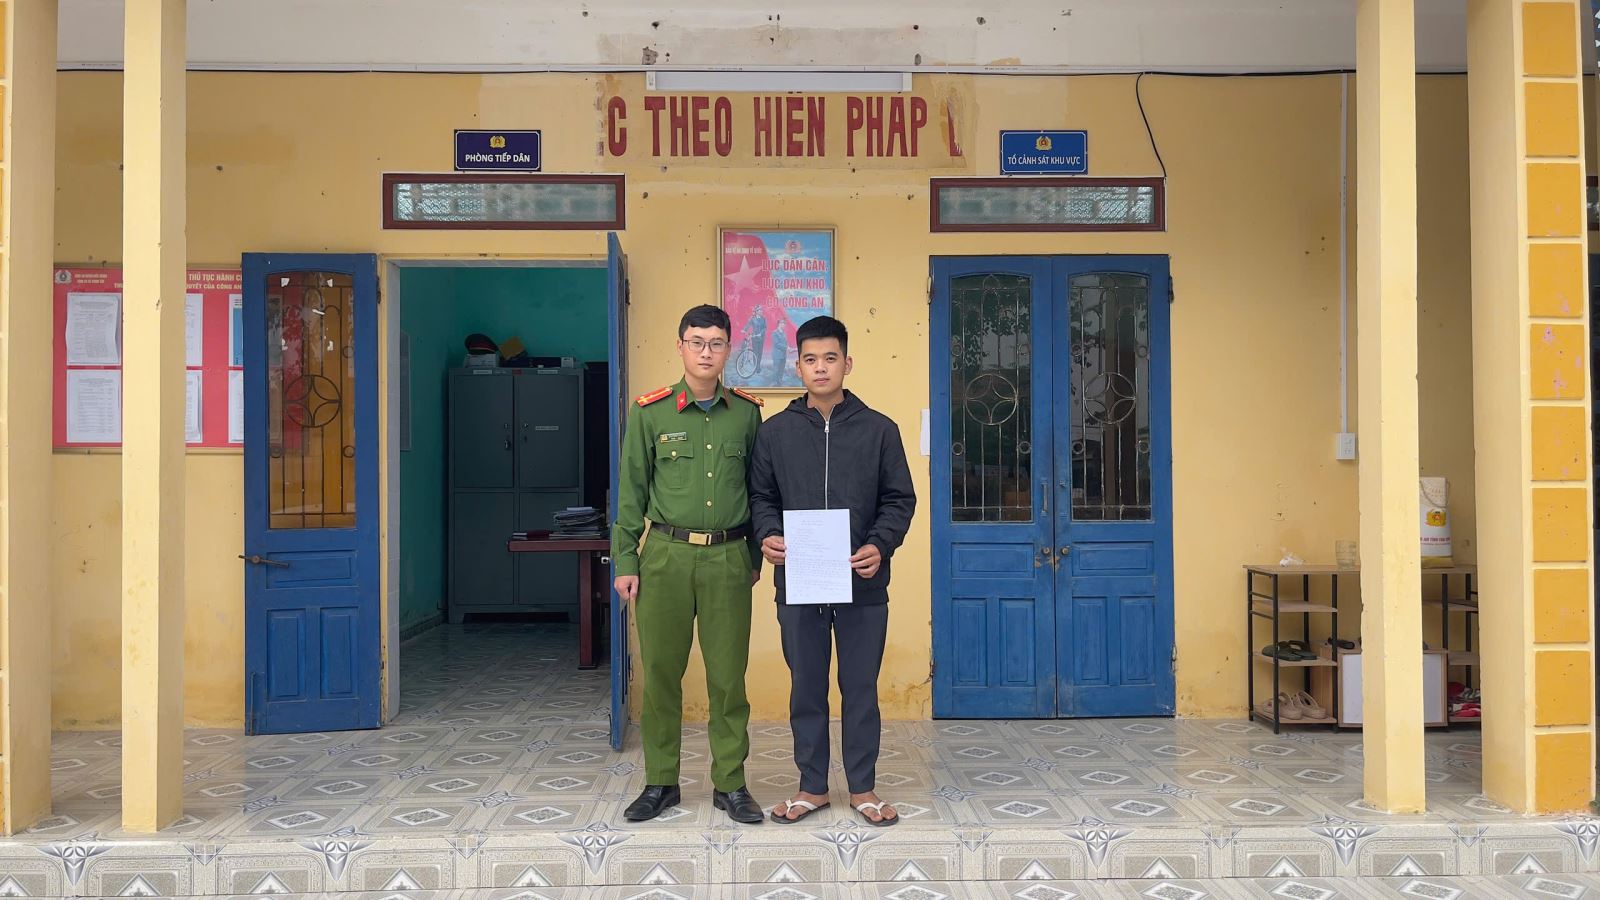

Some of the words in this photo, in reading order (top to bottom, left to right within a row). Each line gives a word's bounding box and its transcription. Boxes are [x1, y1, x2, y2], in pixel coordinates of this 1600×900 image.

[602, 95, 628, 157] C
[644, 96, 732, 157] THEO
[465, 152, 494, 162] PHÒNG
[495, 151, 512, 162] TIẾP
[513, 152, 531, 162] DÂN
[1008, 153, 1017, 165] TỔ
[1018, 154, 1037, 165] CẢNH
[1038, 154, 1050, 165] SÁT
[1051, 156, 1065, 165] KHU
[1066, 156, 1081, 166] VỰC
[188, 272, 201, 281] THỦ
[202, 273, 215, 282] TỤC
